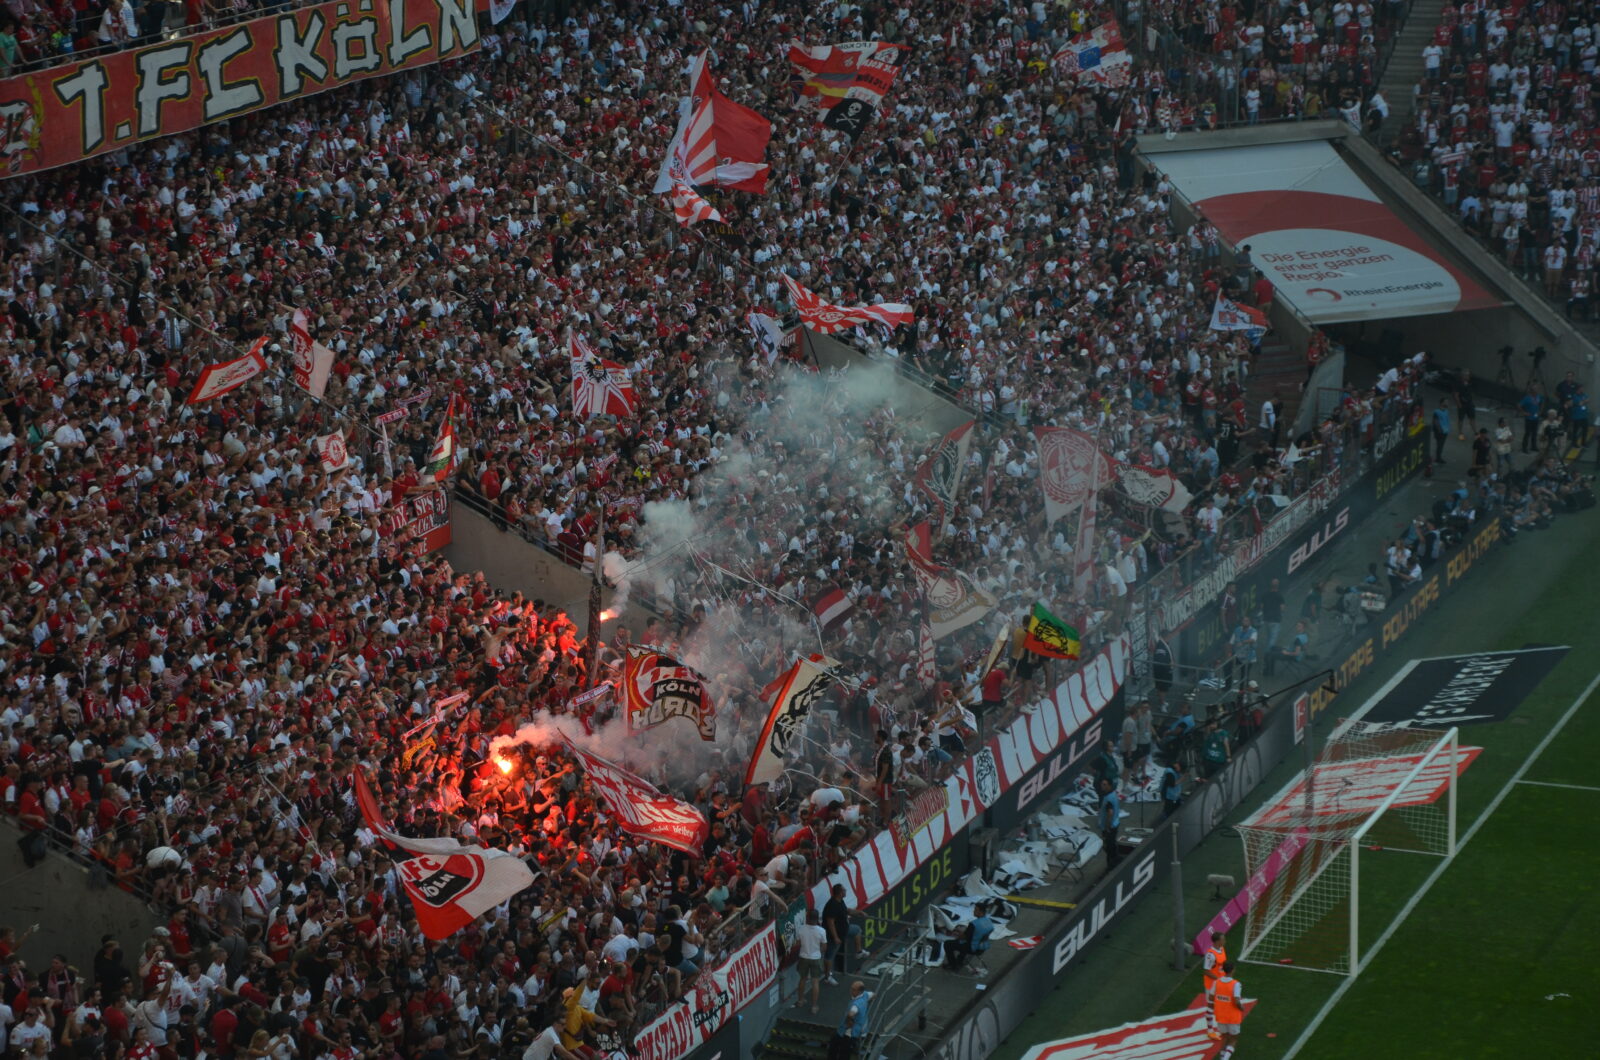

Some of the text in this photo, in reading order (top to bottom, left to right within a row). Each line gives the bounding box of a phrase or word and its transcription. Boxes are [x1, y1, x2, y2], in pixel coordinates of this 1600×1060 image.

[273, 0, 480, 98] KÖLN
[1260, 244, 1371, 264] Die Energie
[1273, 253, 1394, 273] einer ganzen
[1343, 279, 1444, 298] RheinEnergie
[1286, 506, 1350, 575] BULLS
[1446, 517, 1500, 587] POLI-TAPE
[1382, 574, 1440, 649] POLI-TAPE
[656, 679, 701, 698] KÖLN
[1017, 718, 1103, 812] BULLS
[864, 847, 952, 949] BULLS.DE
[1053, 849, 1156, 976] BULLS
